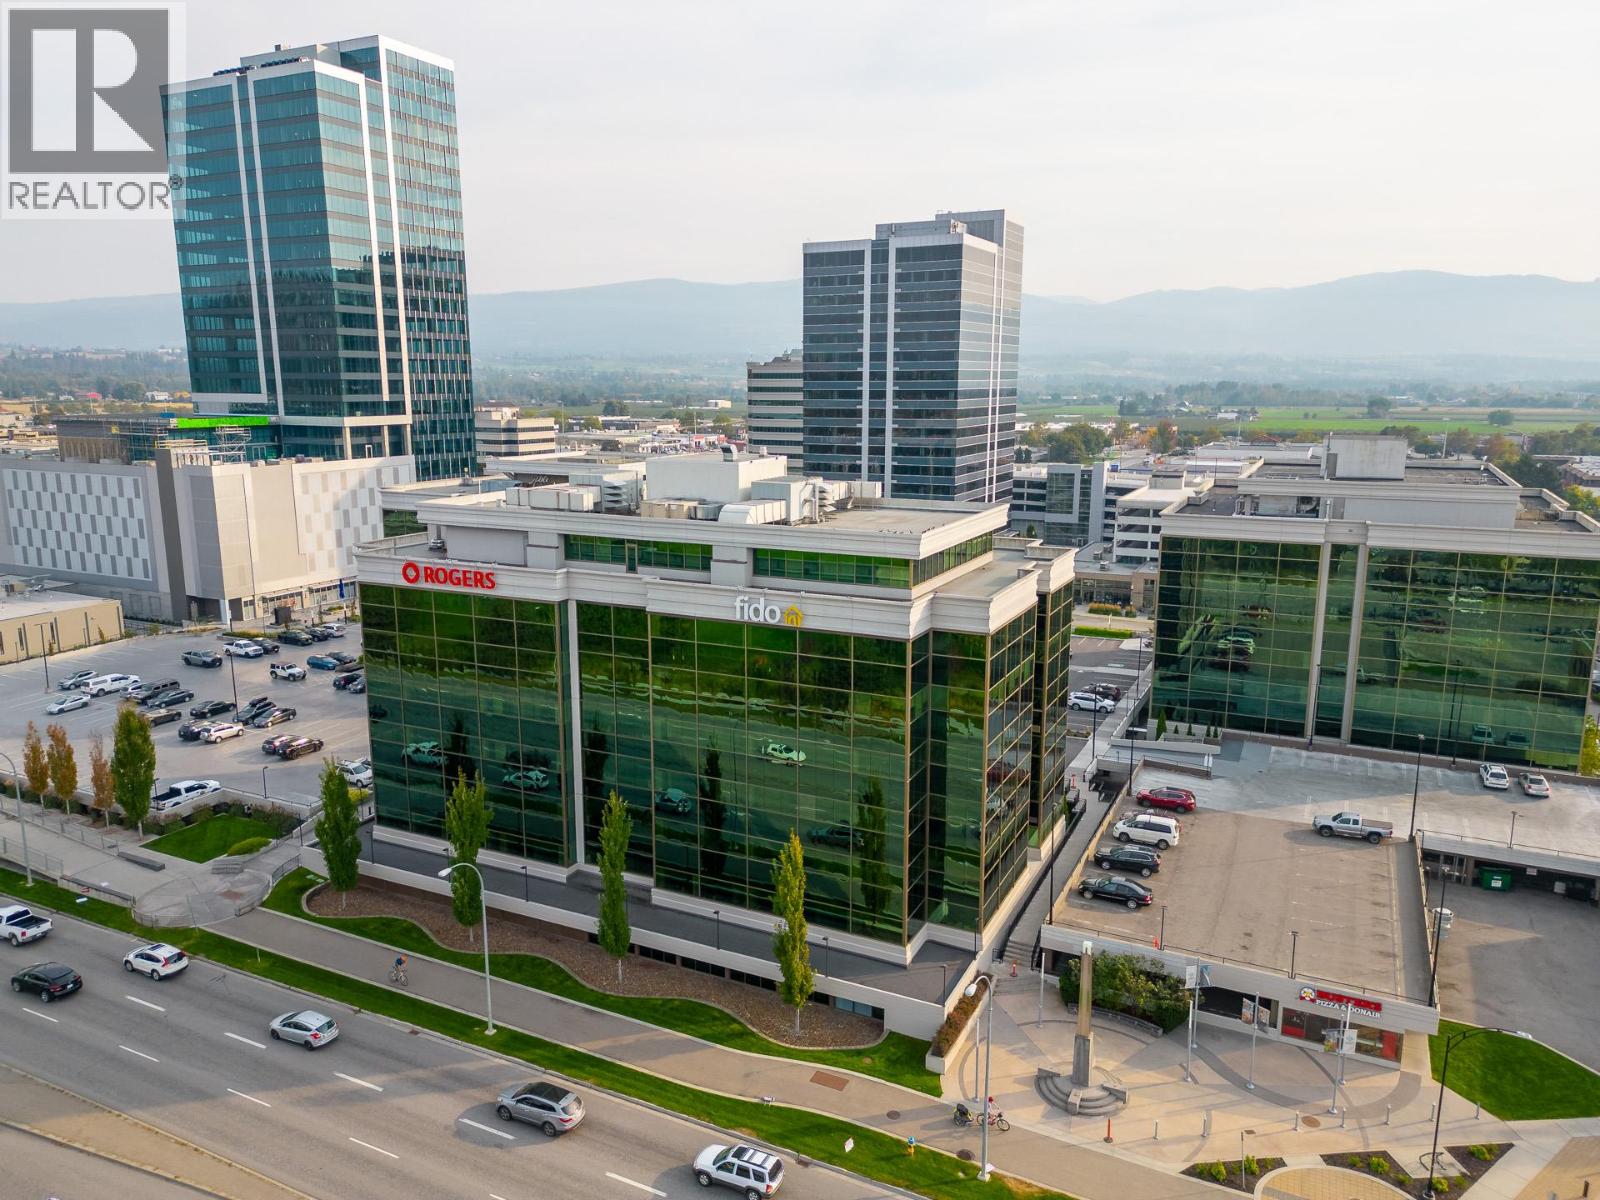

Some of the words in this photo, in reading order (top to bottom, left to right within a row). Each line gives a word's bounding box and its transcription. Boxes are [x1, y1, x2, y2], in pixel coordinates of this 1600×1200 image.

[424, 566, 496, 590] ROGERS
[735, 596, 781, 624] fido
[1316, 999, 1340, 1010] PIZZA
[1349, 1005, 1381, 1018] DONAIR
